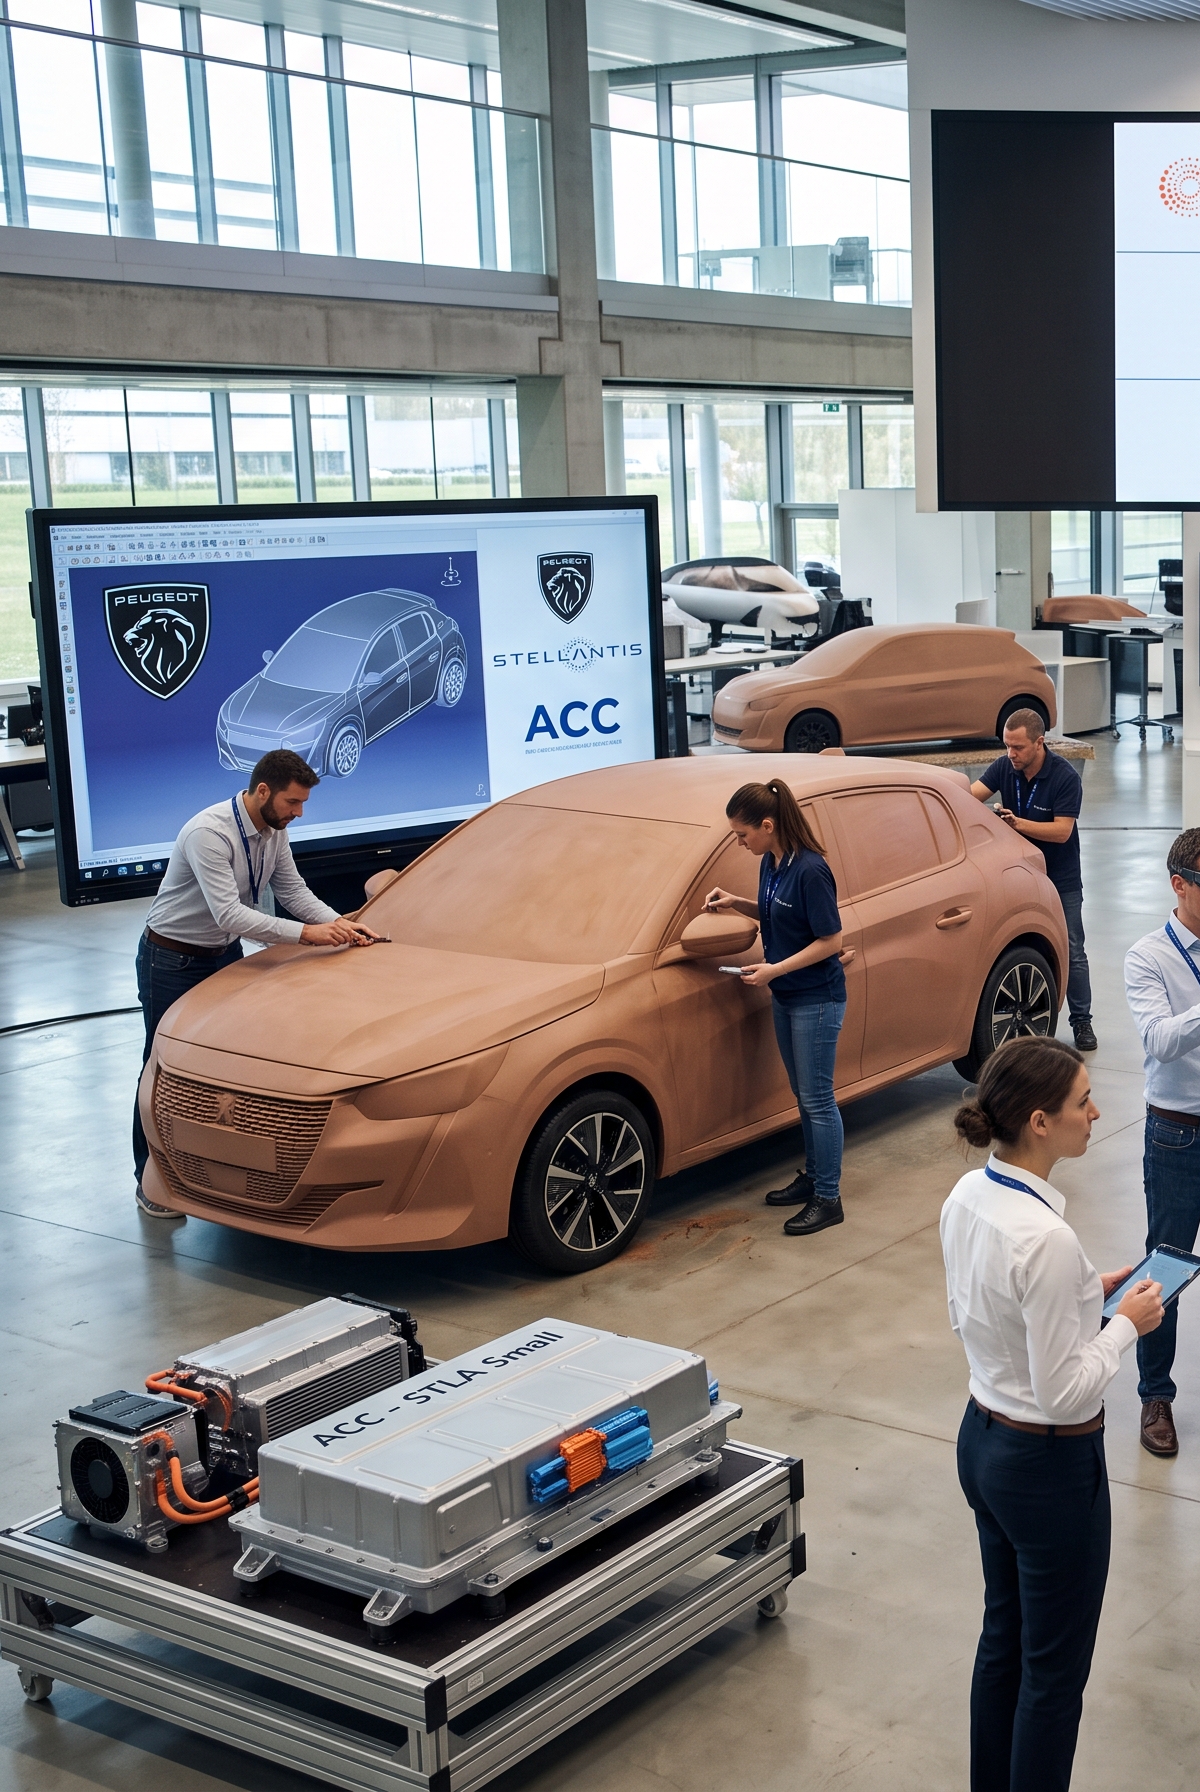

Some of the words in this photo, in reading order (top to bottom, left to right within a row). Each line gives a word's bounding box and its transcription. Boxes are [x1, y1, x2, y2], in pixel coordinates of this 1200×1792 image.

[114, 592, 200, 607] PEUGEOT
[493, 643, 643, 668] STELLANTIS
[524, 697, 621, 743] ACC
[312, 1412, 385, 1448] ACC
[402, 1369, 488, 1405] STLA
[481, 1331, 564, 1368] Small
